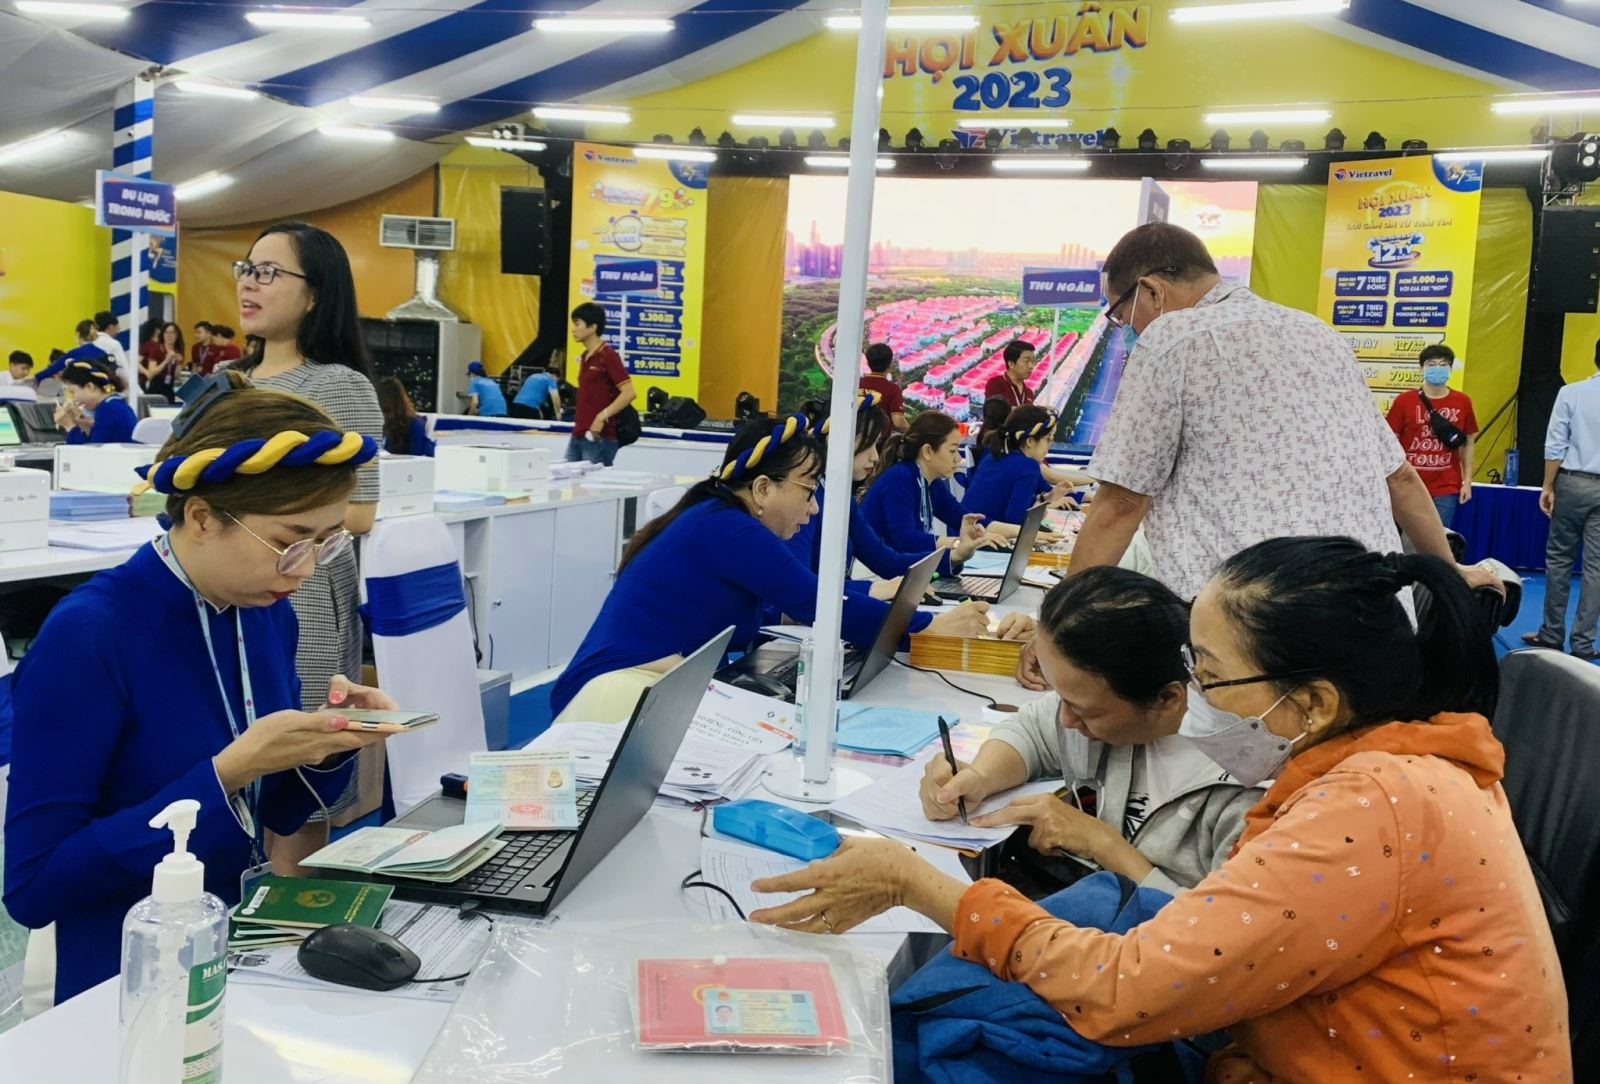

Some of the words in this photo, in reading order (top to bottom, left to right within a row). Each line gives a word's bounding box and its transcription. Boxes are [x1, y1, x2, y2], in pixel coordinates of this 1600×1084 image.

[988, 2, 1151, 67] XUÂN
[952, 67, 1072, 110] 2023
[1349, 168, 1393, 179] Vietravel
[121, 188, 137, 201] DU
[138, 191, 160, 206] LỊCH
[108, 202, 143, 219] TRONG
[144, 208, 172, 223] NƯỚC
[1378, 204, 1412, 218] 2023
[1373, 244, 1397, 263] 12
[600, 270, 622, 281] THU
[622, 270, 654, 282] NGÂN
[1356, 276, 1367, 290] 7
[1412, 275, 1436, 284] 5.000
[1029, 280, 1053, 291] THU
[1056, 280, 1096, 293] NGÂN
[1358, 303, 1365, 317] 1
